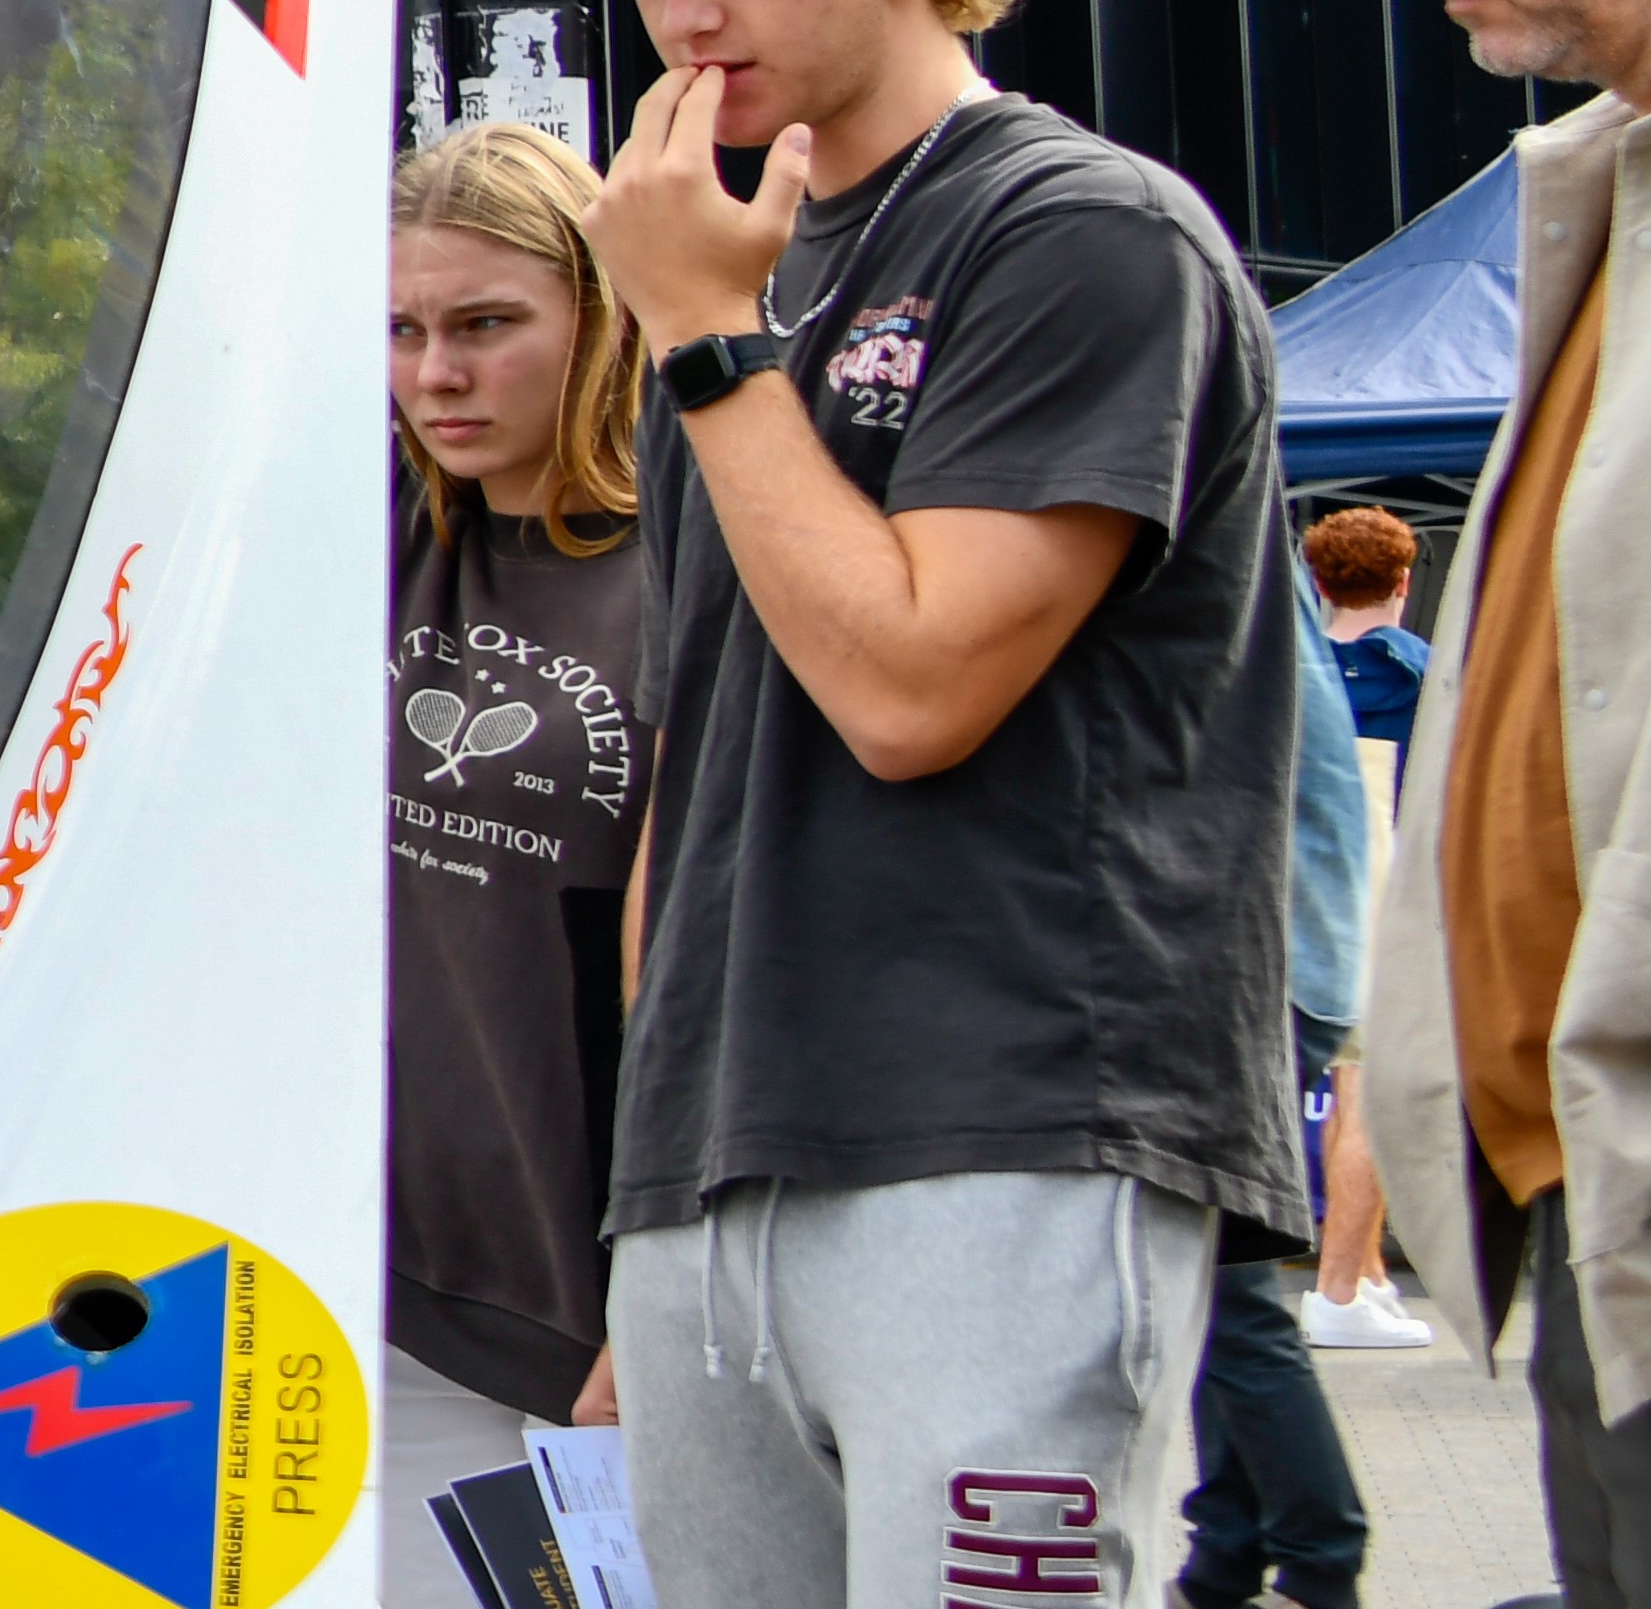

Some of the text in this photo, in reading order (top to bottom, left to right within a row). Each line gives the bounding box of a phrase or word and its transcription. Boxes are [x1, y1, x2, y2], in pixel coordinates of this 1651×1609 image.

[512, 770, 556, 796] 2013
[538, 654, 632, 820] SOCIETY
[441, 809, 564, 864] EDITION
[218, 1259, 259, 1607] EMERGENCY ELECTRICAL ISOLATION
[271, 1350, 325, 1517] PRESS
[940, 1466, 1102, 1609] CH
